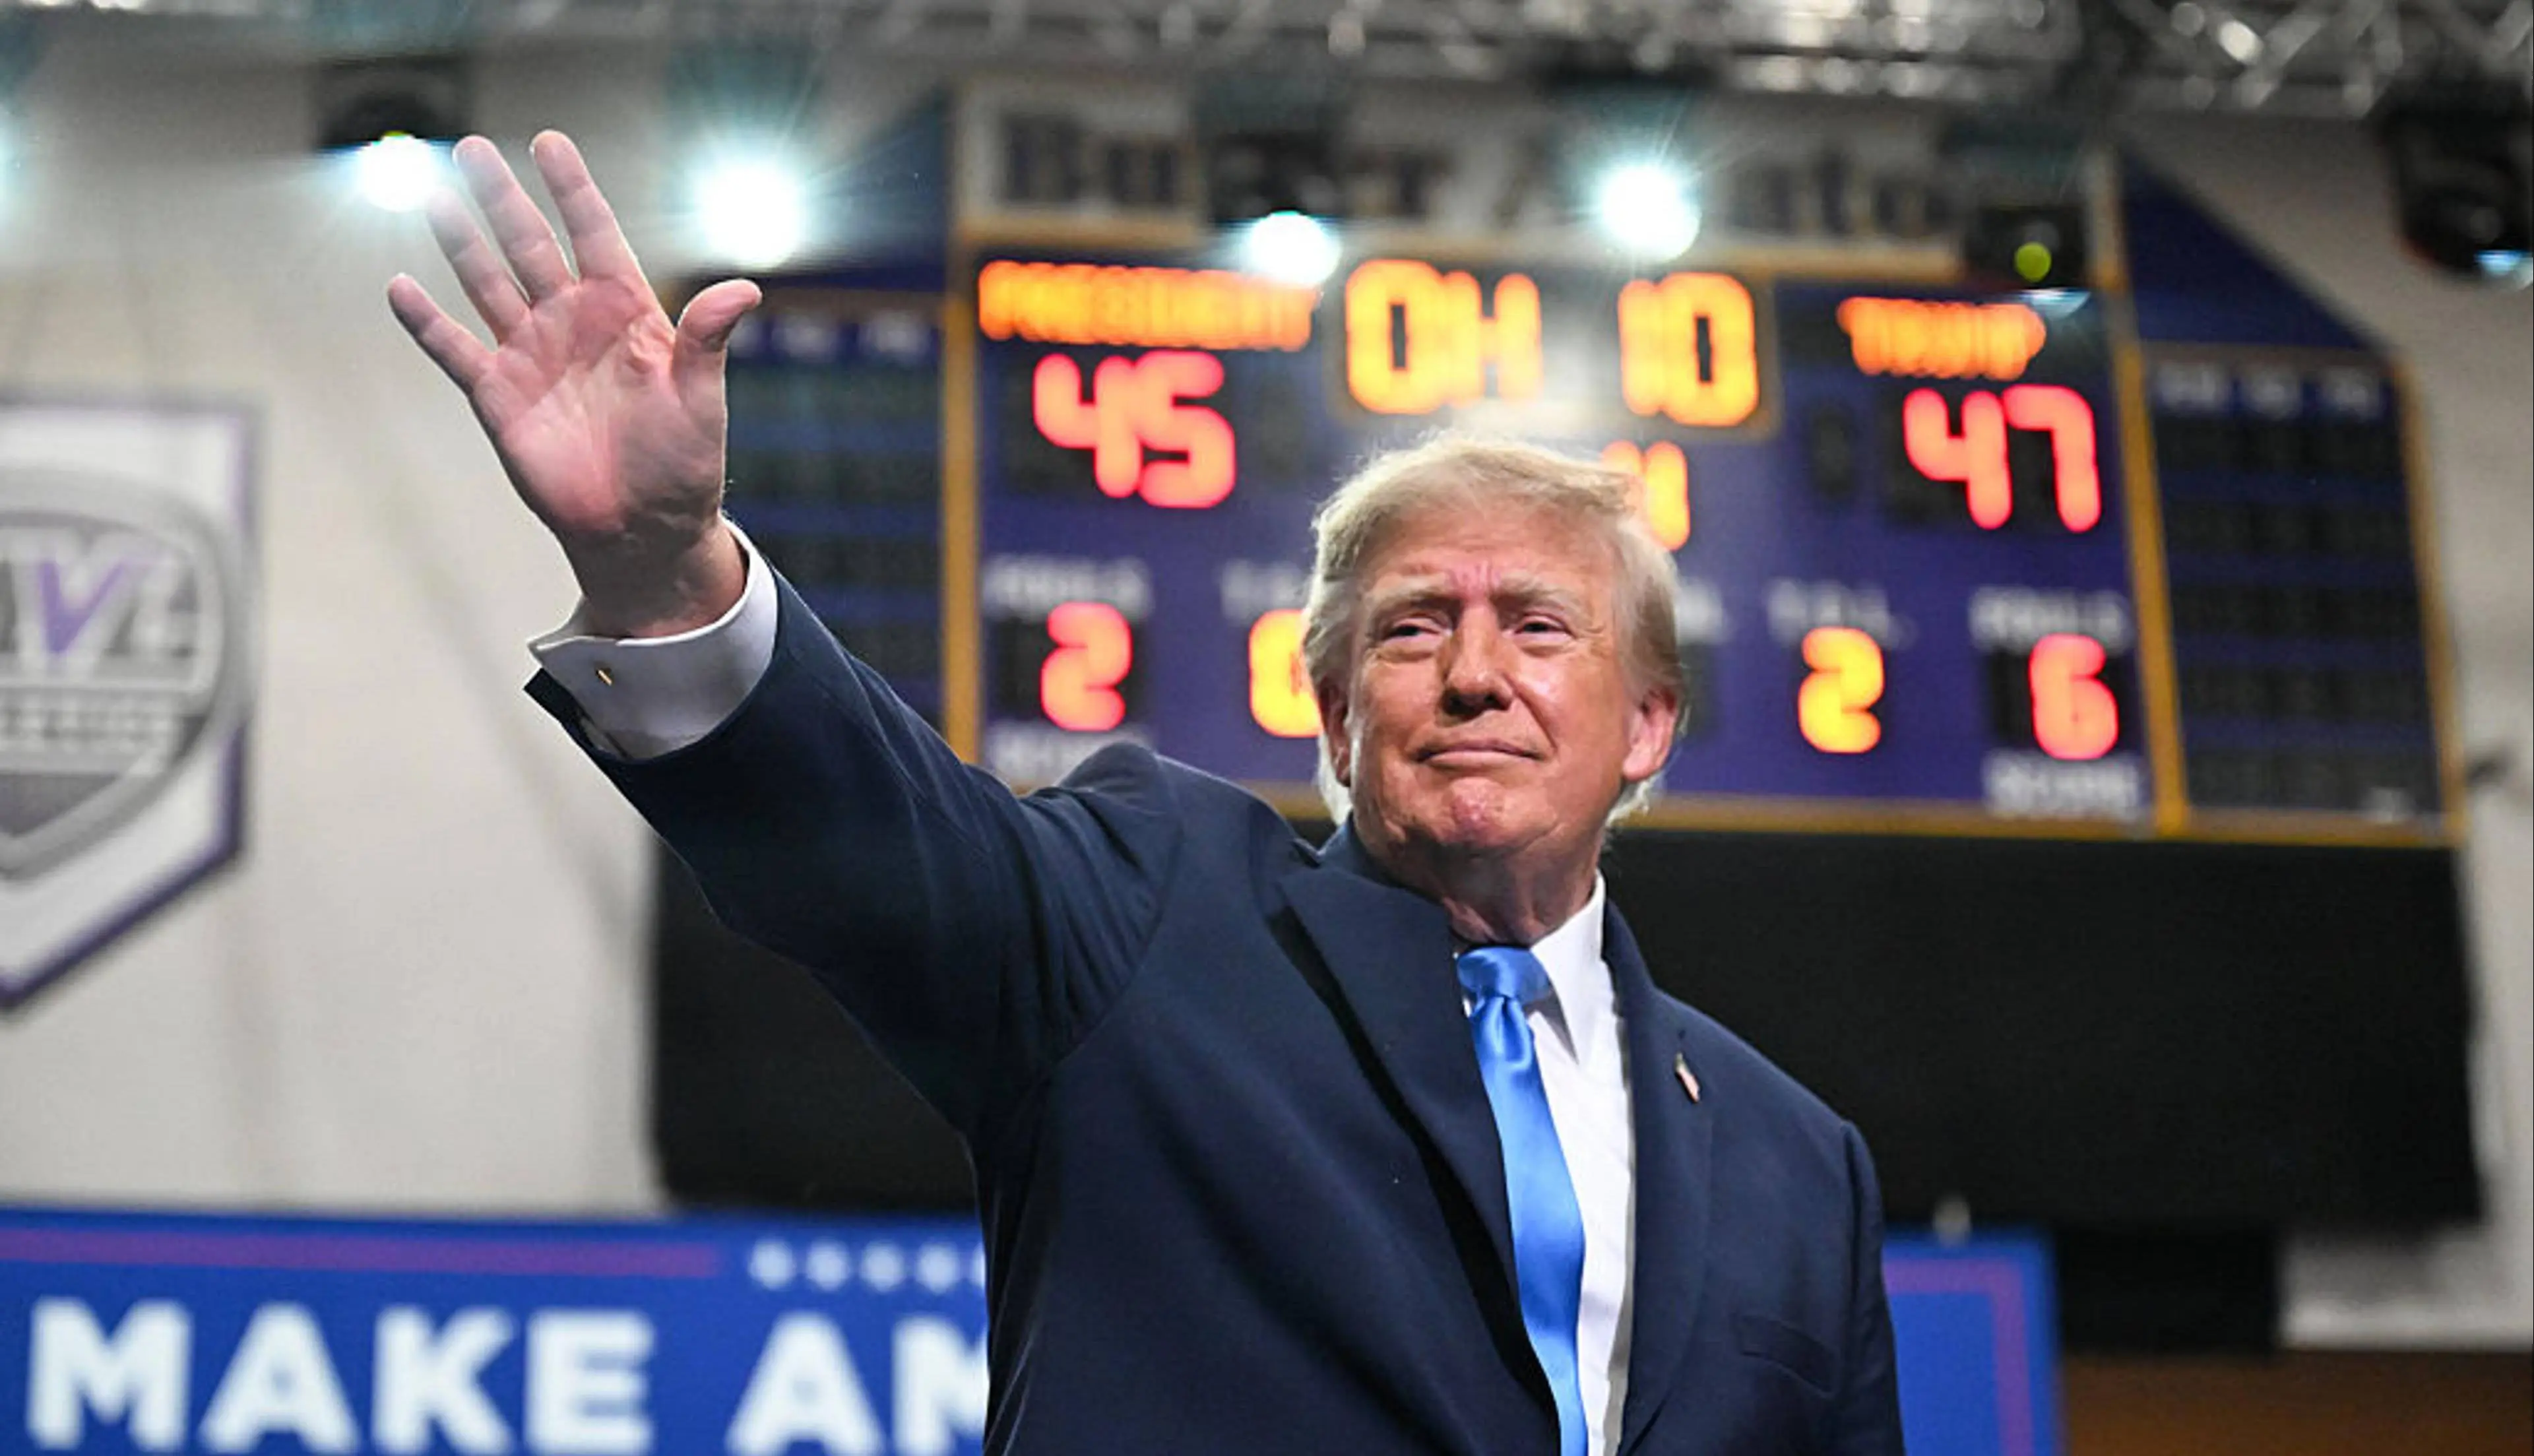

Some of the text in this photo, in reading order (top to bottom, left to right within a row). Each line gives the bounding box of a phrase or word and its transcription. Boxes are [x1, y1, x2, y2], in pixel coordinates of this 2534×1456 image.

[1032, 353, 1236, 509] 45
[1903, 385, 2102, 533] 47
[1040, 601, 1133, 731] 2
[1798, 625, 1885, 753] 2
[2029, 632, 2119, 760] 6
[26, 1296, 654, 1456] MAKE
